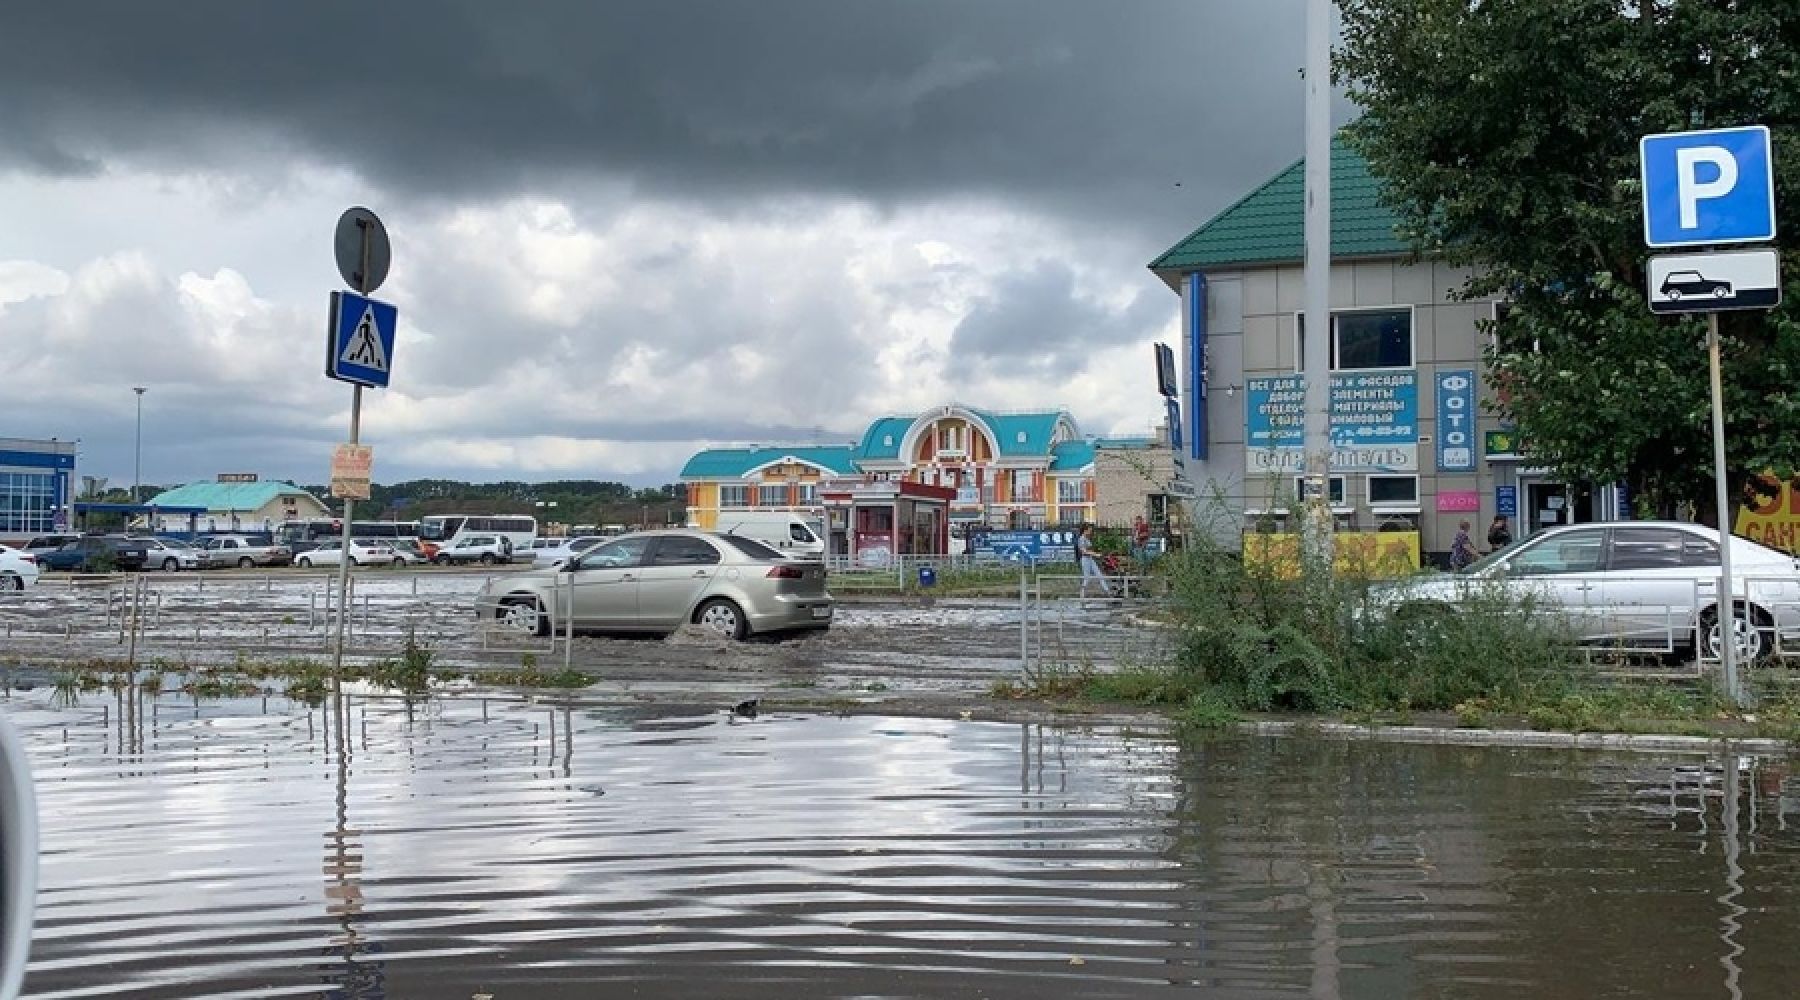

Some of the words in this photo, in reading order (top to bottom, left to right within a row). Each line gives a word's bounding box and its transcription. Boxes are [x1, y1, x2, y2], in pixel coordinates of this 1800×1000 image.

[1677, 146, 1738, 229] P
[1334, 400, 1405, 412] МАТЕРИАЛЫ
[1441, 376, 1469, 445] ФОТО
[1439, 496, 1477, 506] AVON
